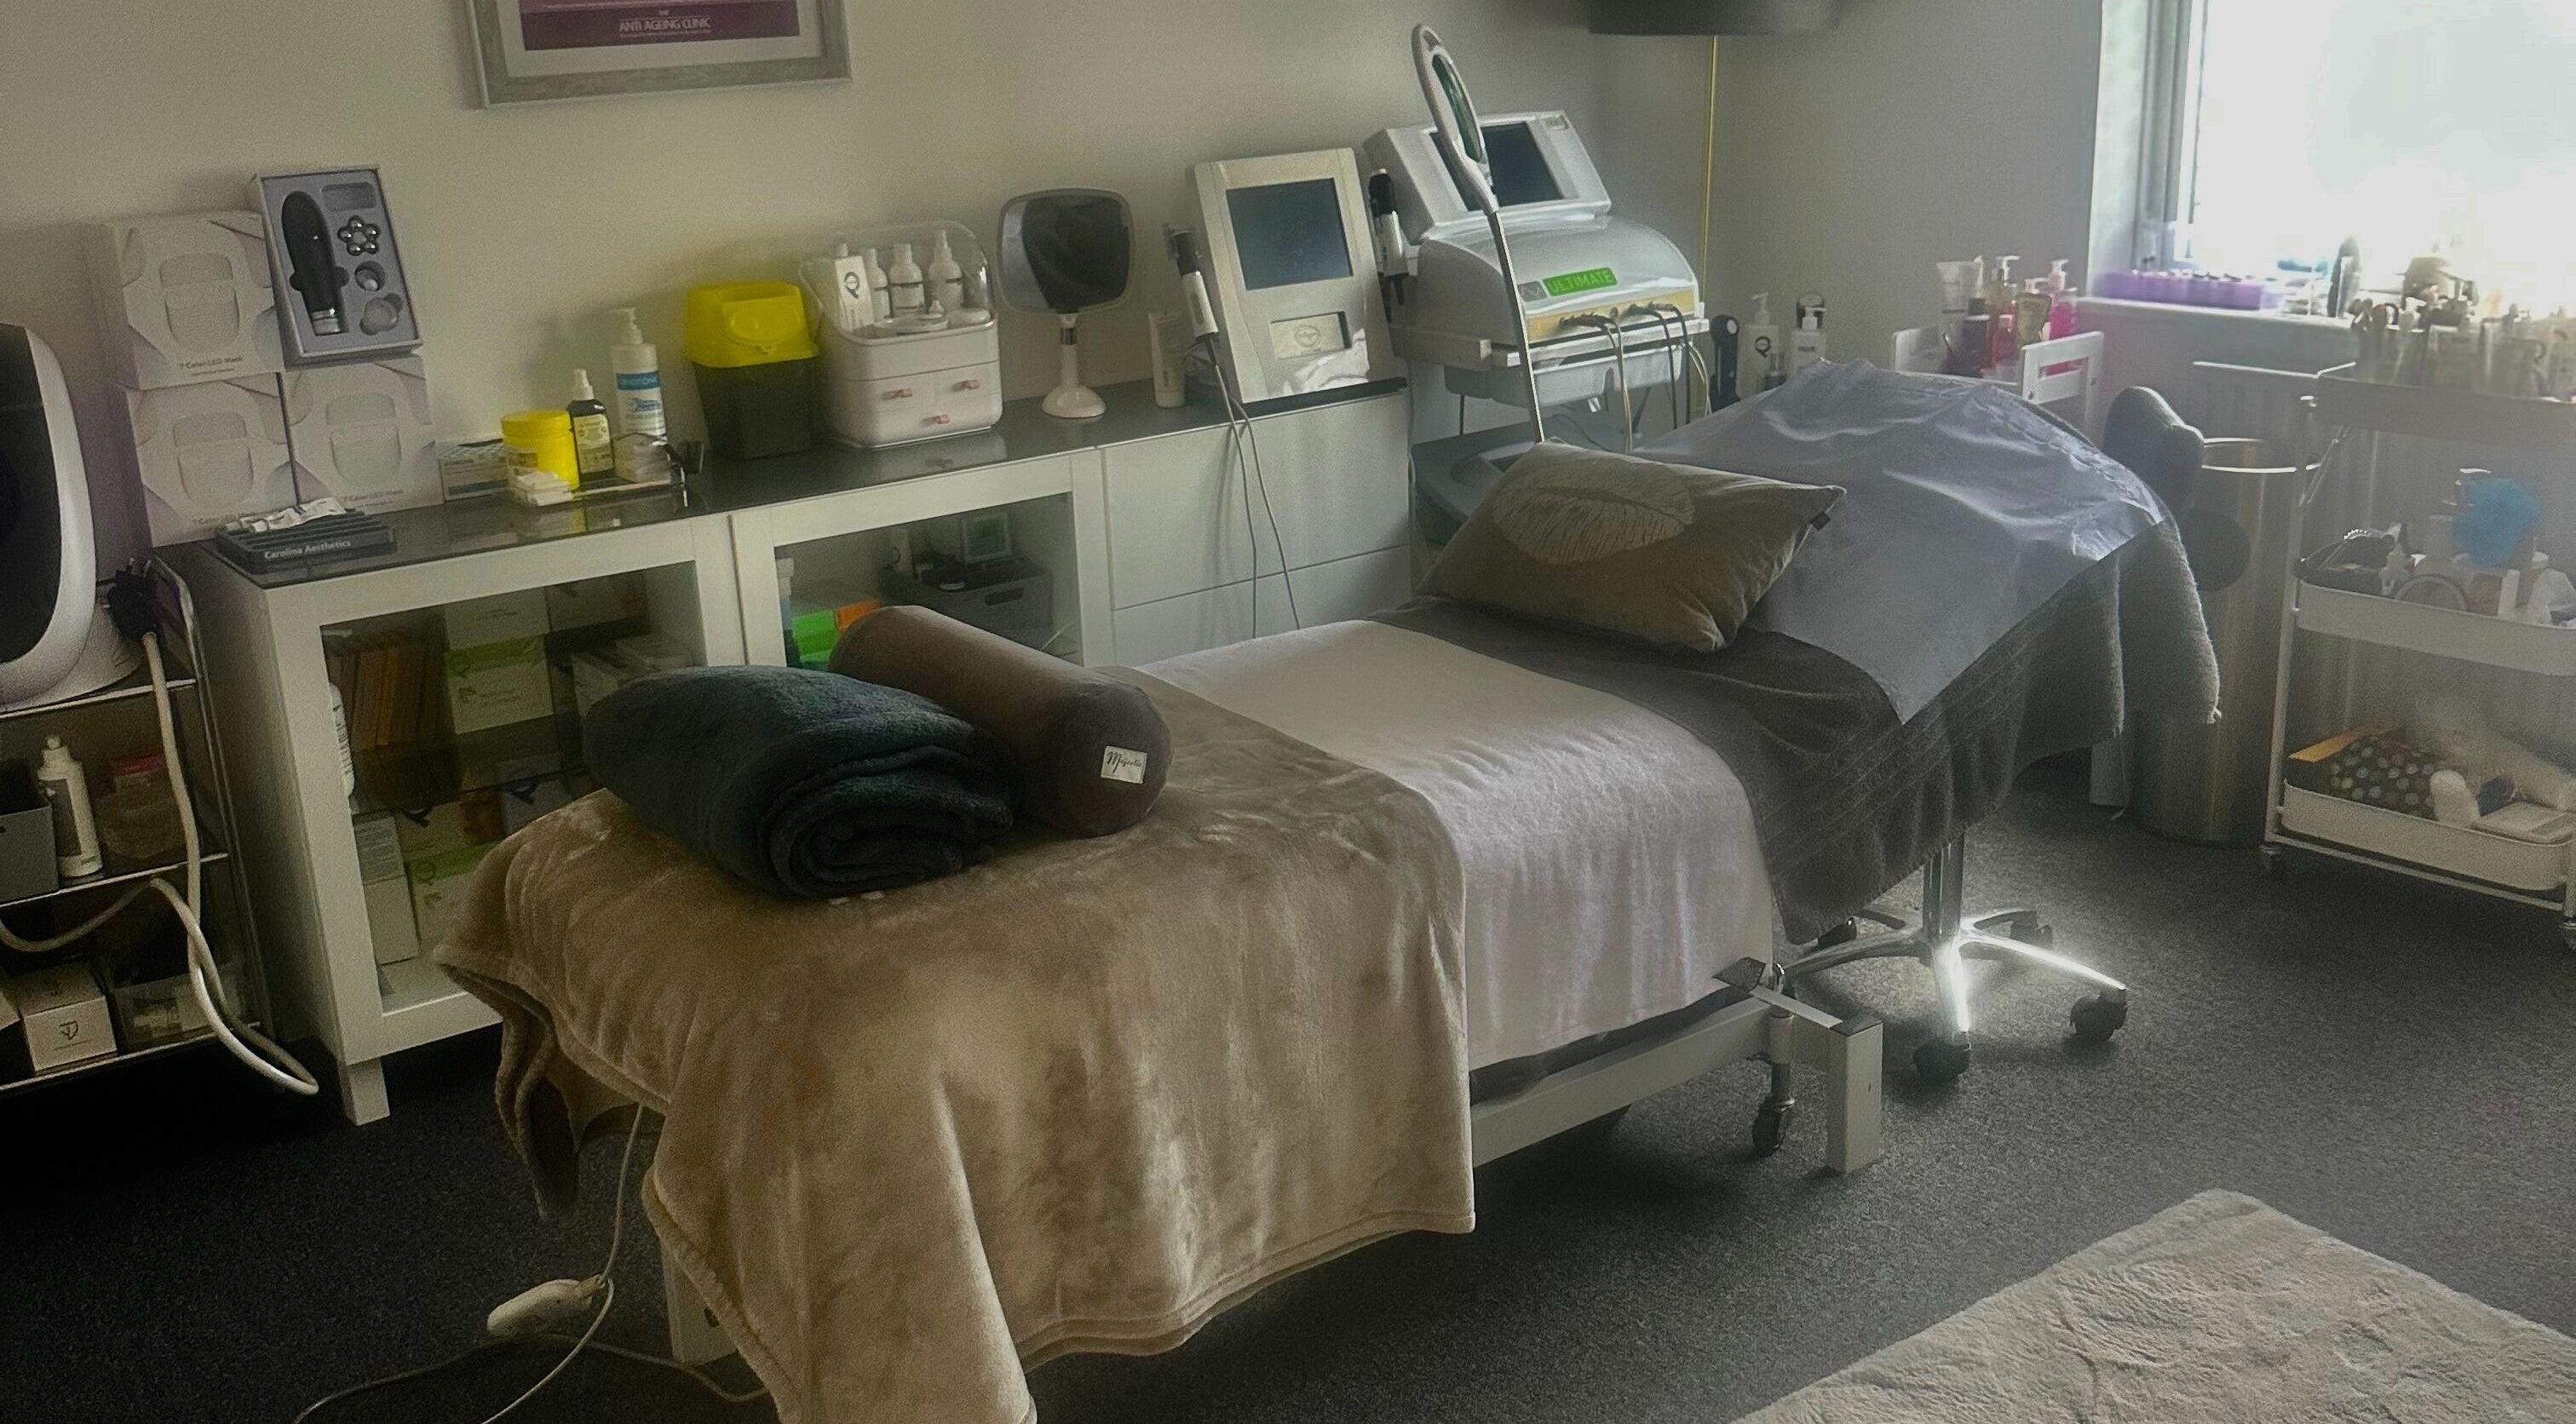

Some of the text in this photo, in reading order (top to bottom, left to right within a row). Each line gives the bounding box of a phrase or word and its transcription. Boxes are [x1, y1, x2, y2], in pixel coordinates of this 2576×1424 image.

[619, 17, 711, 32] ANTI AGEING CLINIC
[1547, 269, 1615, 294] ULTIMATE
